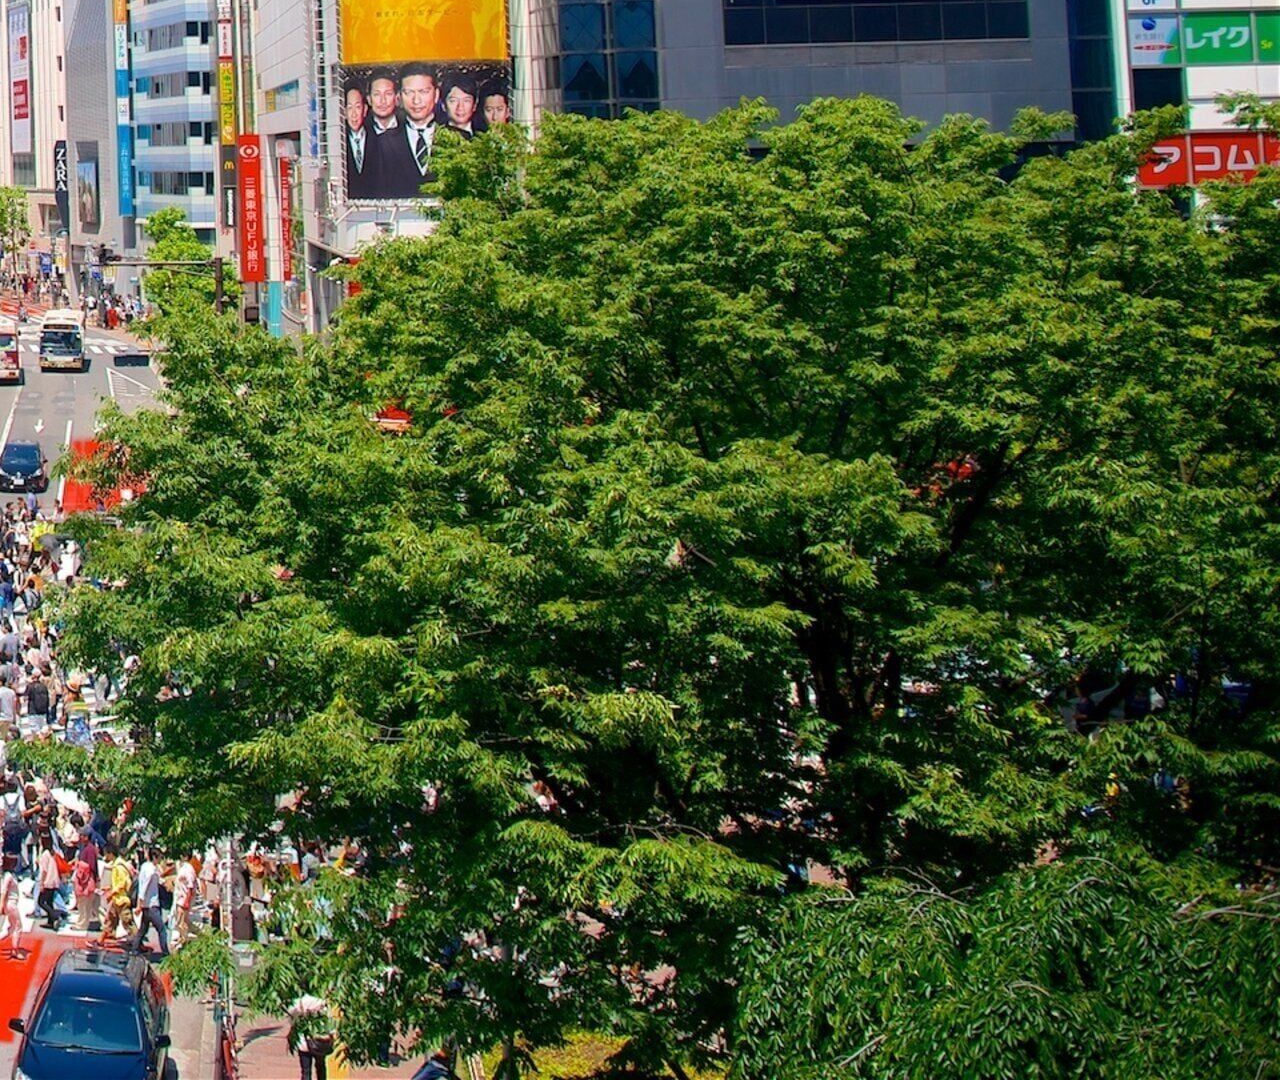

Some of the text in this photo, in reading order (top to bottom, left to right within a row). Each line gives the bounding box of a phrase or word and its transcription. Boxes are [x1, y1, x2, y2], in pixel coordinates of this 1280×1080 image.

[1185, 26, 1250, 49] レイク
[55, 148, 68, 192] ZARA
[1152, 144, 1255, 174] アコム
[244, 176, 259, 273] 三菱東京UFJ銀行
